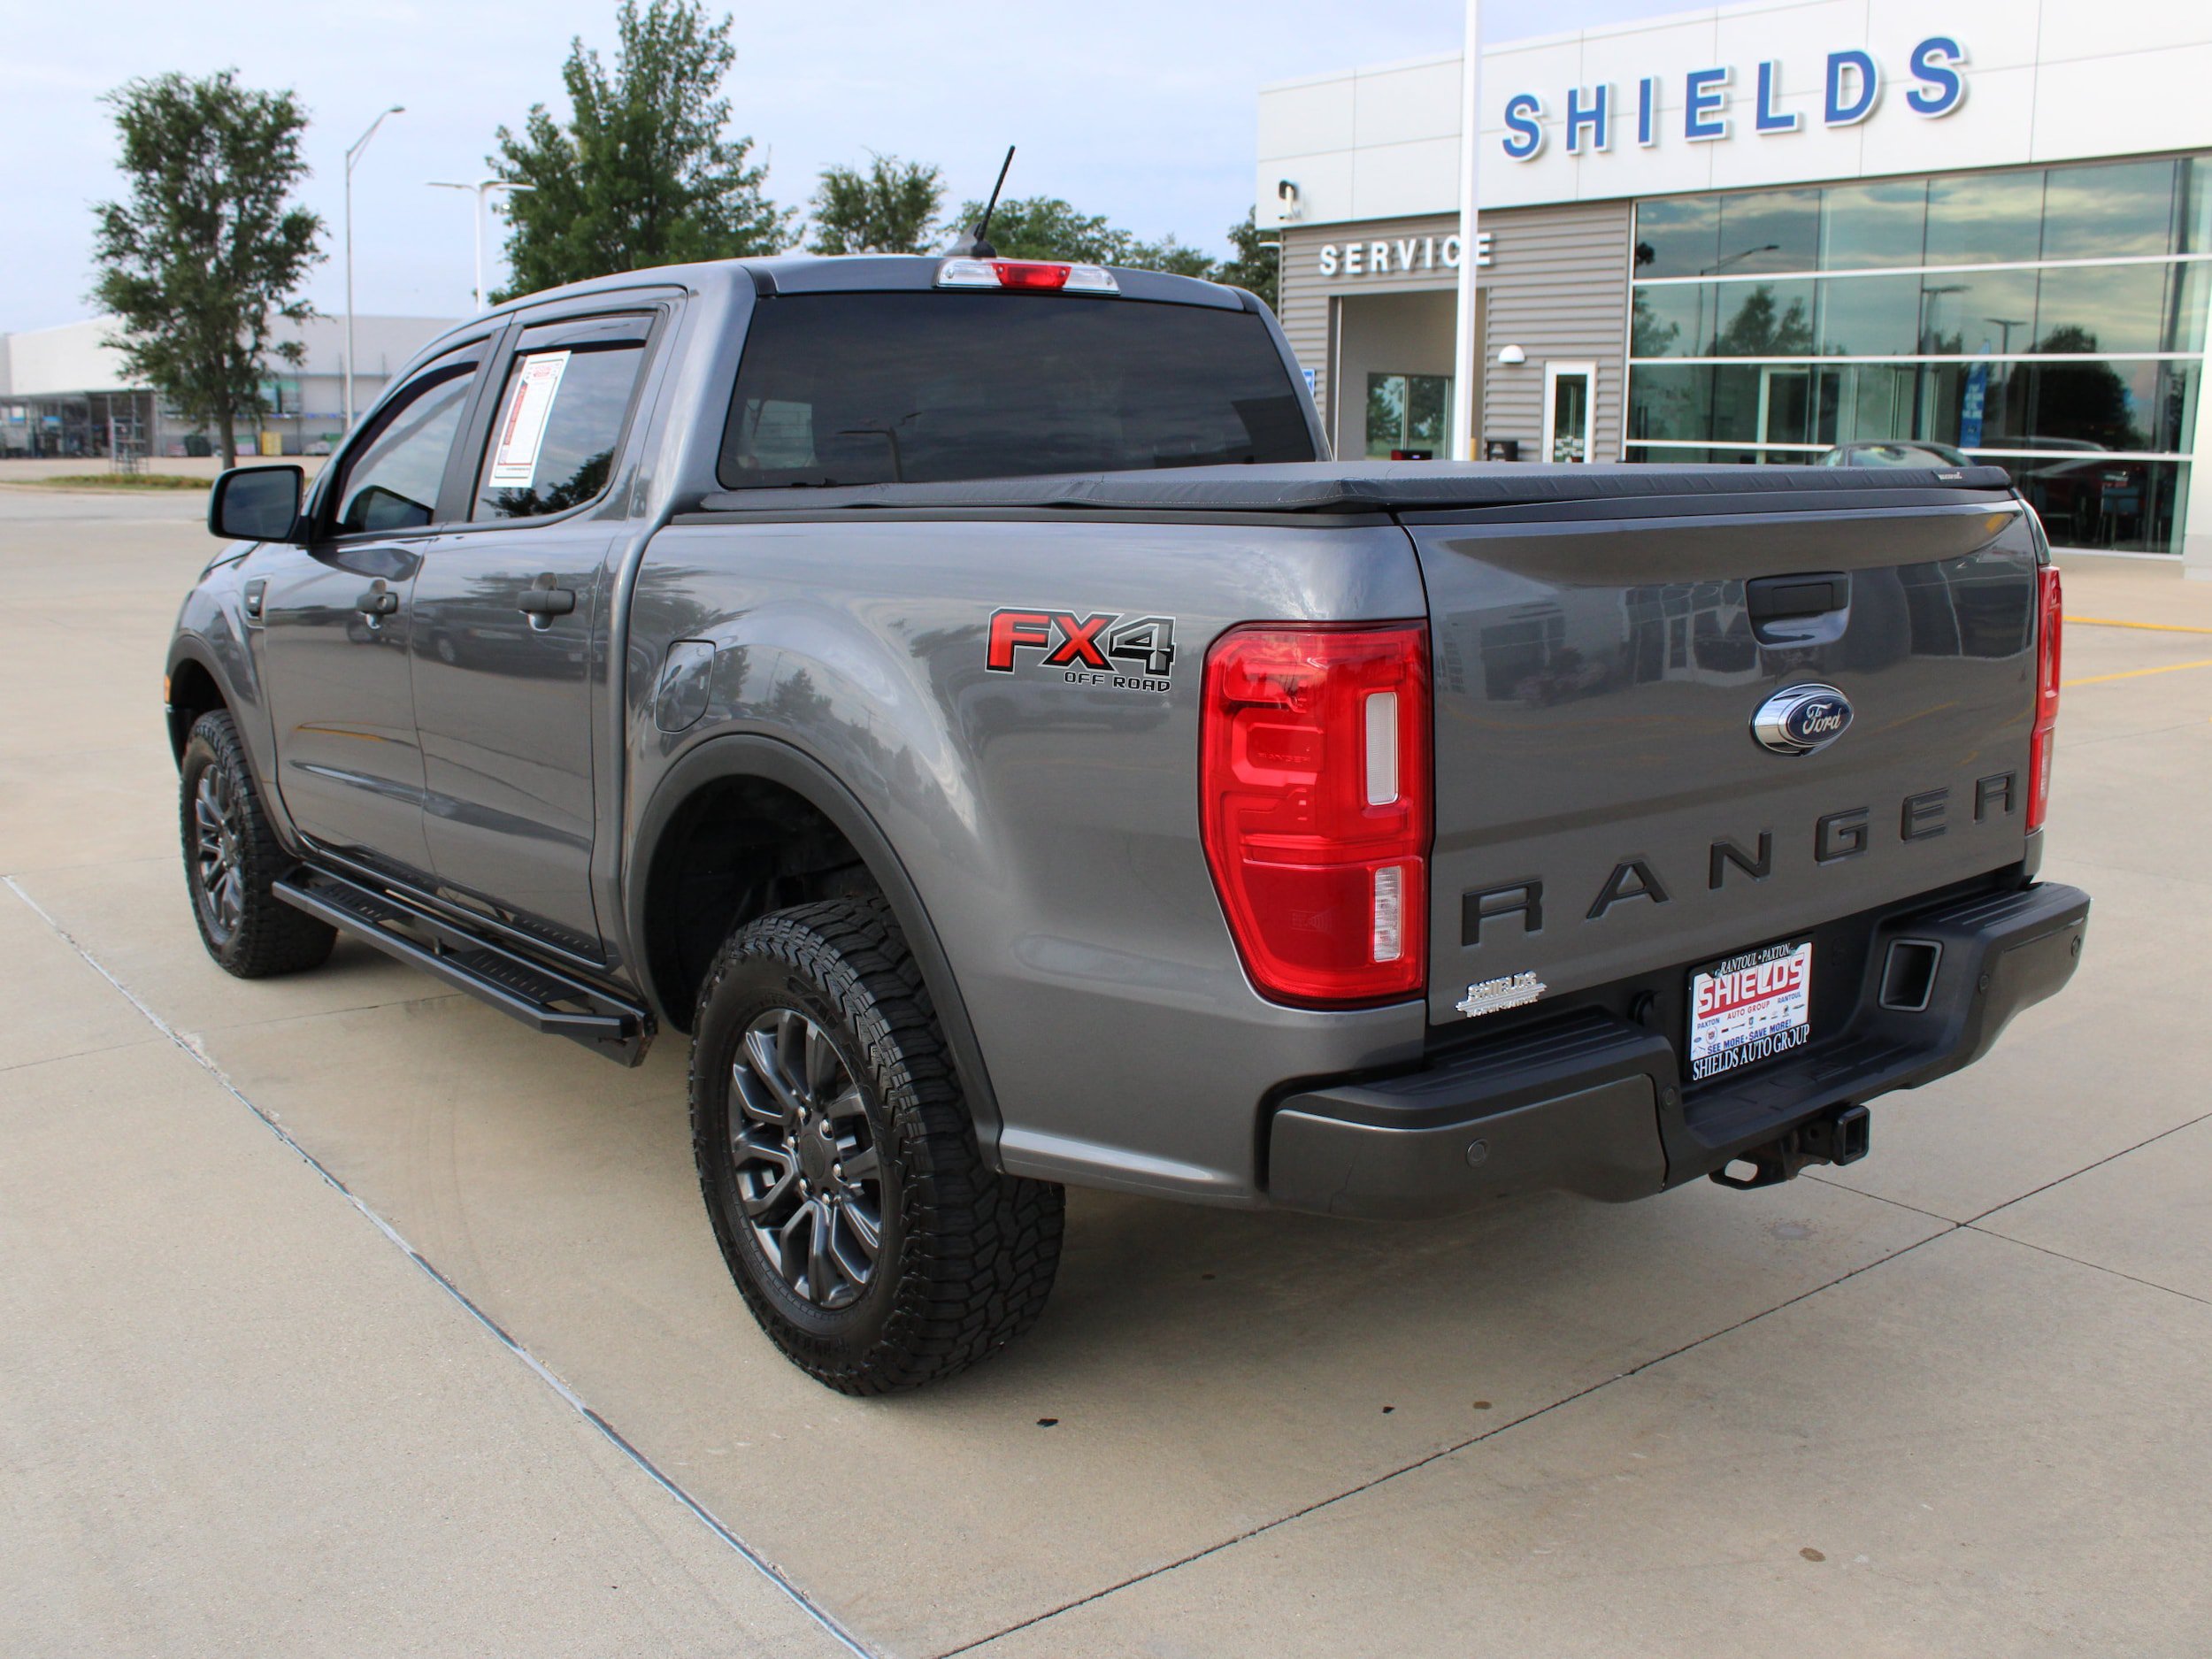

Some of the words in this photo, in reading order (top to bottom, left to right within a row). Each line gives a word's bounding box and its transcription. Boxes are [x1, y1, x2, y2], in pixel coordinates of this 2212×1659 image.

[1502, 35, 1968, 163] SHIELDS
[1318, 232, 1492, 276] SERVICE
[985, 606, 1177, 679] FX4
[1064, 671, 1105, 687] OFF
[1112, 676, 1171, 693] ROAD
[1802, 703, 1841, 734] Ford
[1461, 771, 2016, 948] RANGER
[1721, 953, 1757, 975] RANTOUL
[1698, 952, 1805, 1015] SHIELDS
[1777, 991, 1801, 1004] RANTOUL
[1697, 1018, 1720, 1030] PAXTON
[1726, 1009, 1746, 1020] AUTO
[1747, 1001, 1770, 1014] GROUP
[1693, 1048, 1740, 1081] SHIELDS
[1740, 1036, 1772, 1064] AUTO
[1772, 1024, 1810, 1052] GROUP
[1708, 1043, 1721, 1055] SEE
[1724, 1035, 1744, 1048] MORE
[1748, 1027, 1767, 1041] SAVE
[1770, 1018, 1792, 1032] MORE!
